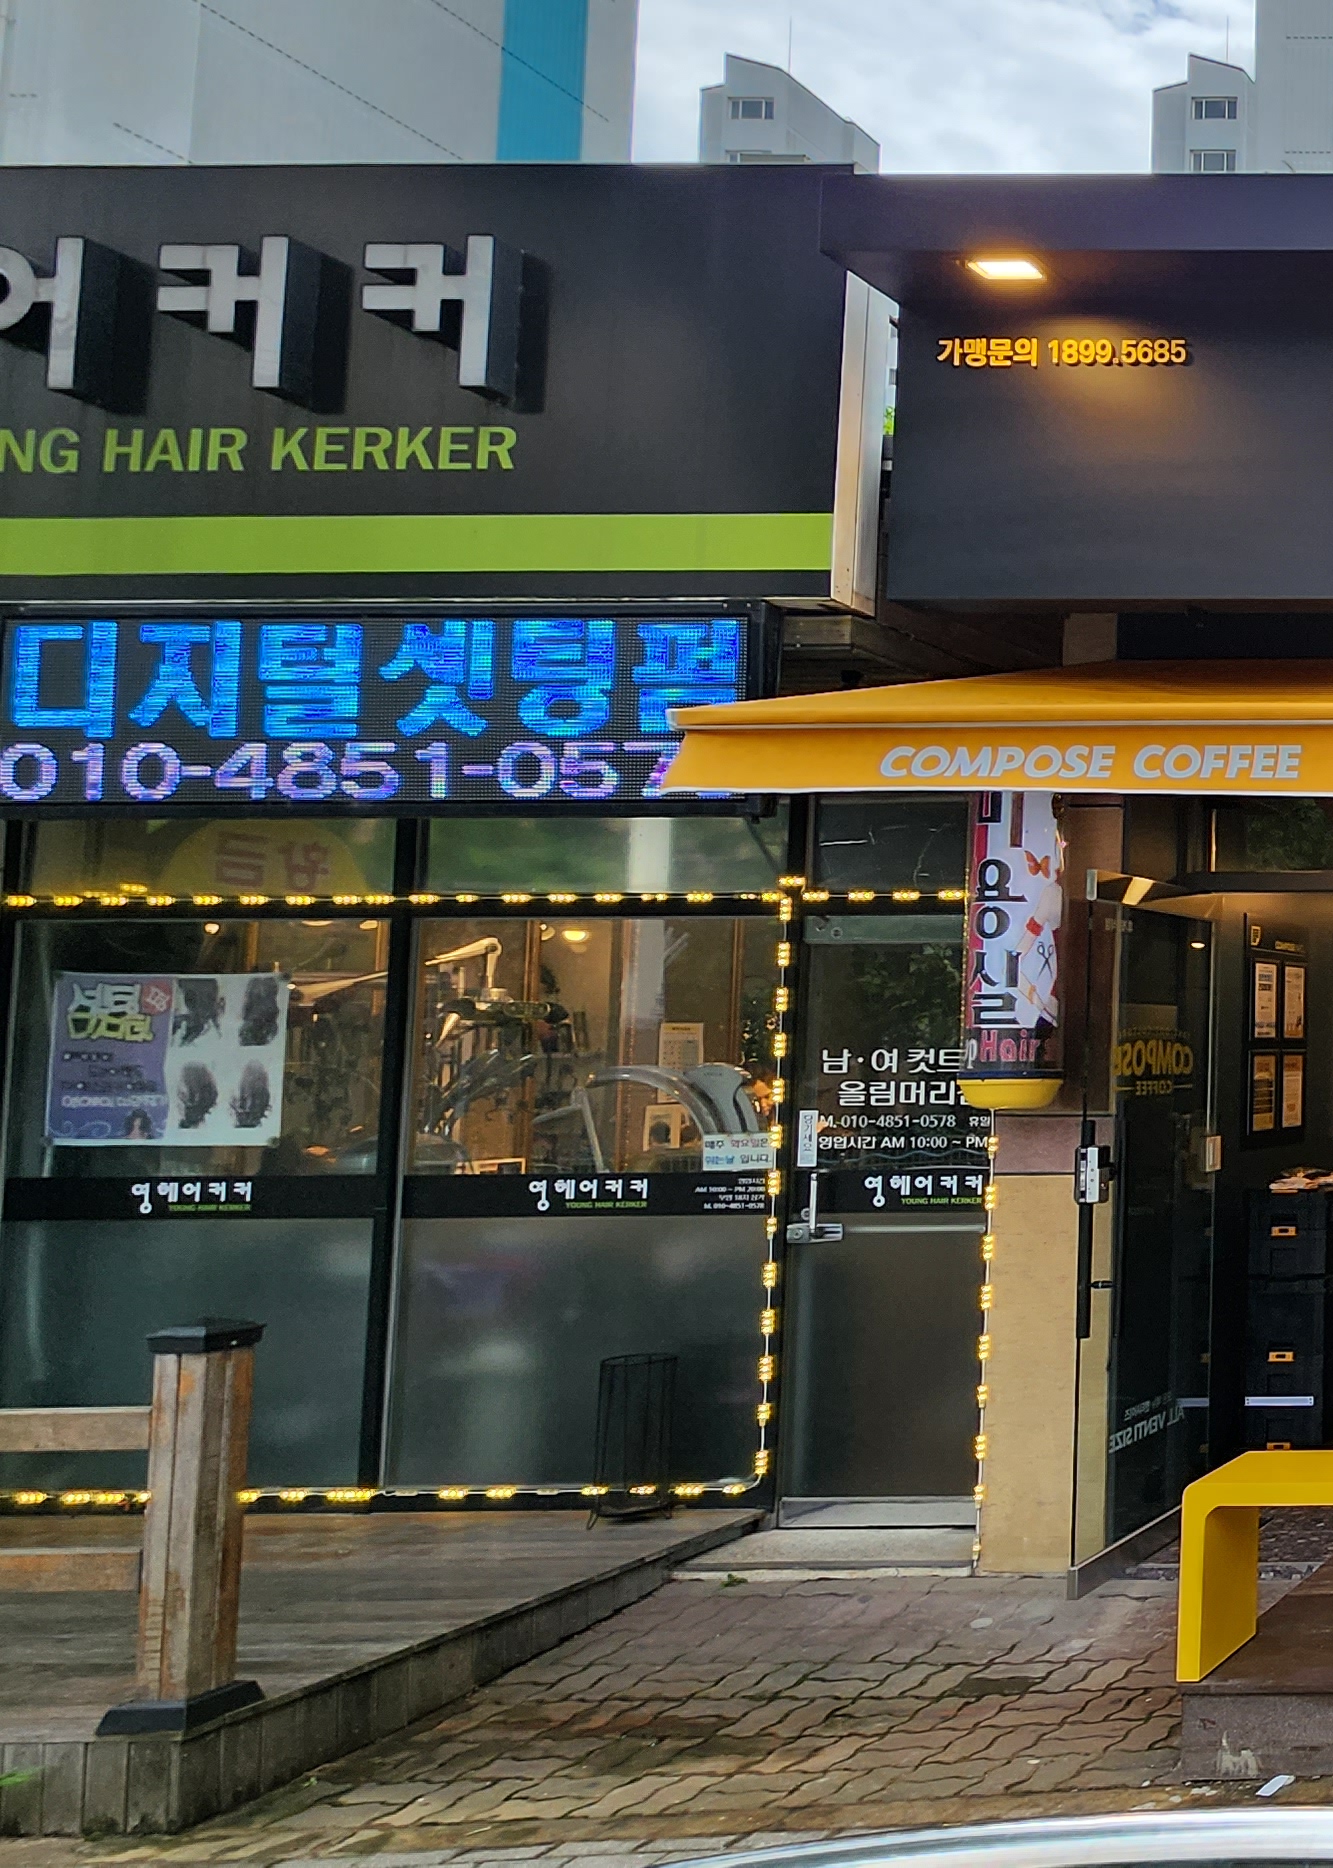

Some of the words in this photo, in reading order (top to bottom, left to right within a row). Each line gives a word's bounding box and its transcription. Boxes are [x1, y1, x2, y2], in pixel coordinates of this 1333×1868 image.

[937, 338, 1038, 367] 가맹문의
[1047, 339, 1187, 365] 1899.5685
[103, 427, 248, 473] HAIR
[270, 426, 519, 473] KERKER
[0, 741, 732, 800] 010-4851-057
[879, 744, 1116, 778] COMPOSE
[1132, 744, 1302, 780] COFFEE
[979, 1029, 1041, 1062] Hair
[838, 1081, 969, 1106] 올림머리
[840, 1114, 956, 1129] 010-4851-0578
[818, 1136, 876, 1150] 영업시간
[880, 1137, 905, 1149] AM
[910, 1136, 948, 1149] 10:00
[965, 1136, 988, 1149] PM
